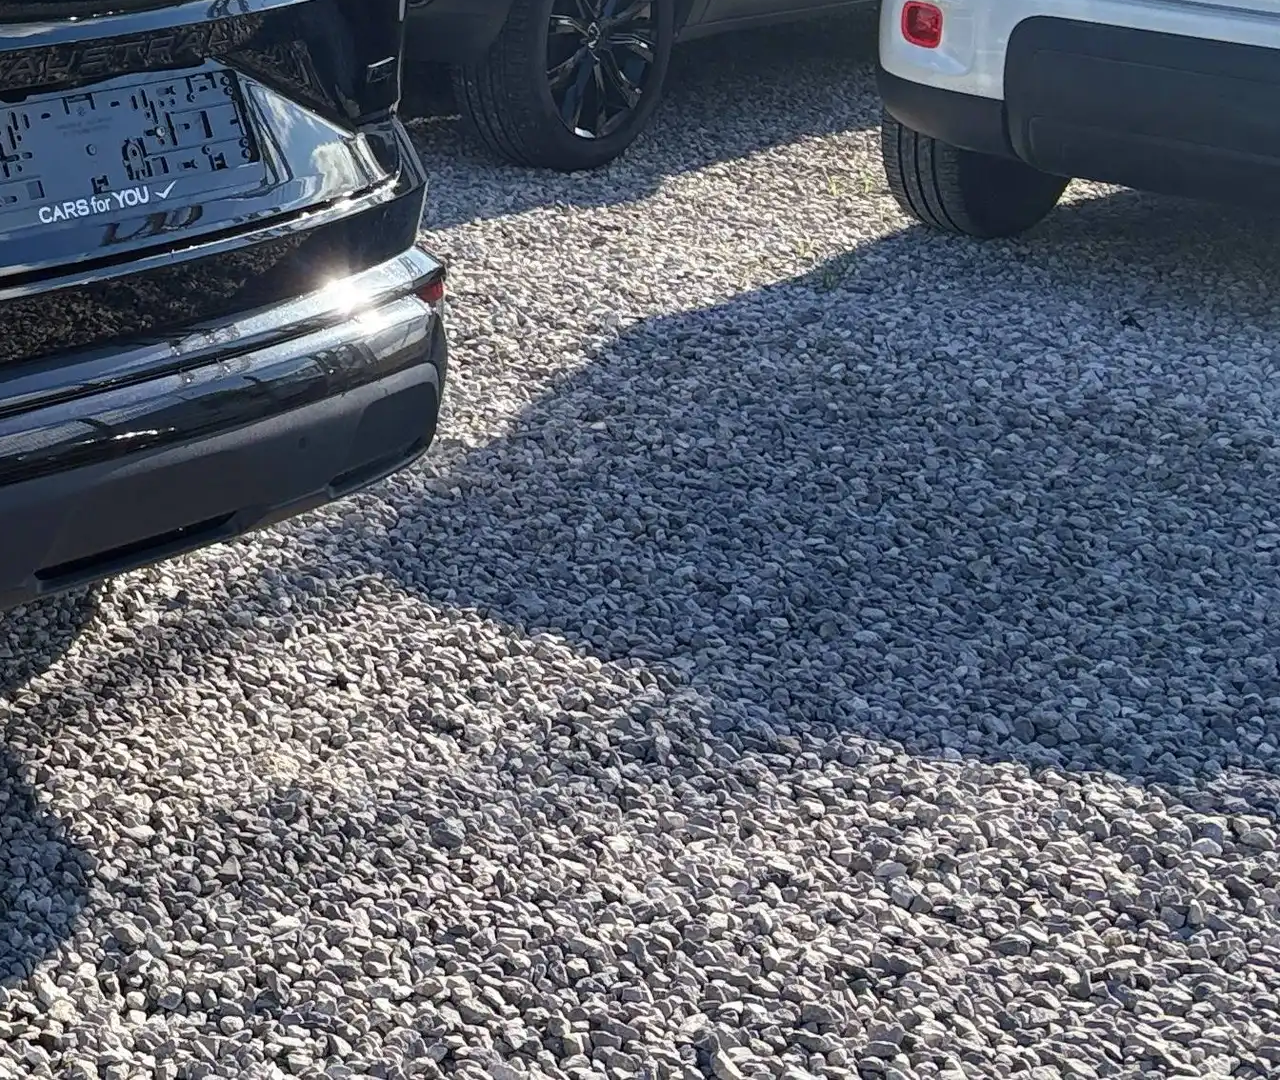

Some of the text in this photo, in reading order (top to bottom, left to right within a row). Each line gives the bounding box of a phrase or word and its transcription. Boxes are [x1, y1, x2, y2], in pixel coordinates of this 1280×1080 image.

[38, 185, 150, 223] CARS for YOU
